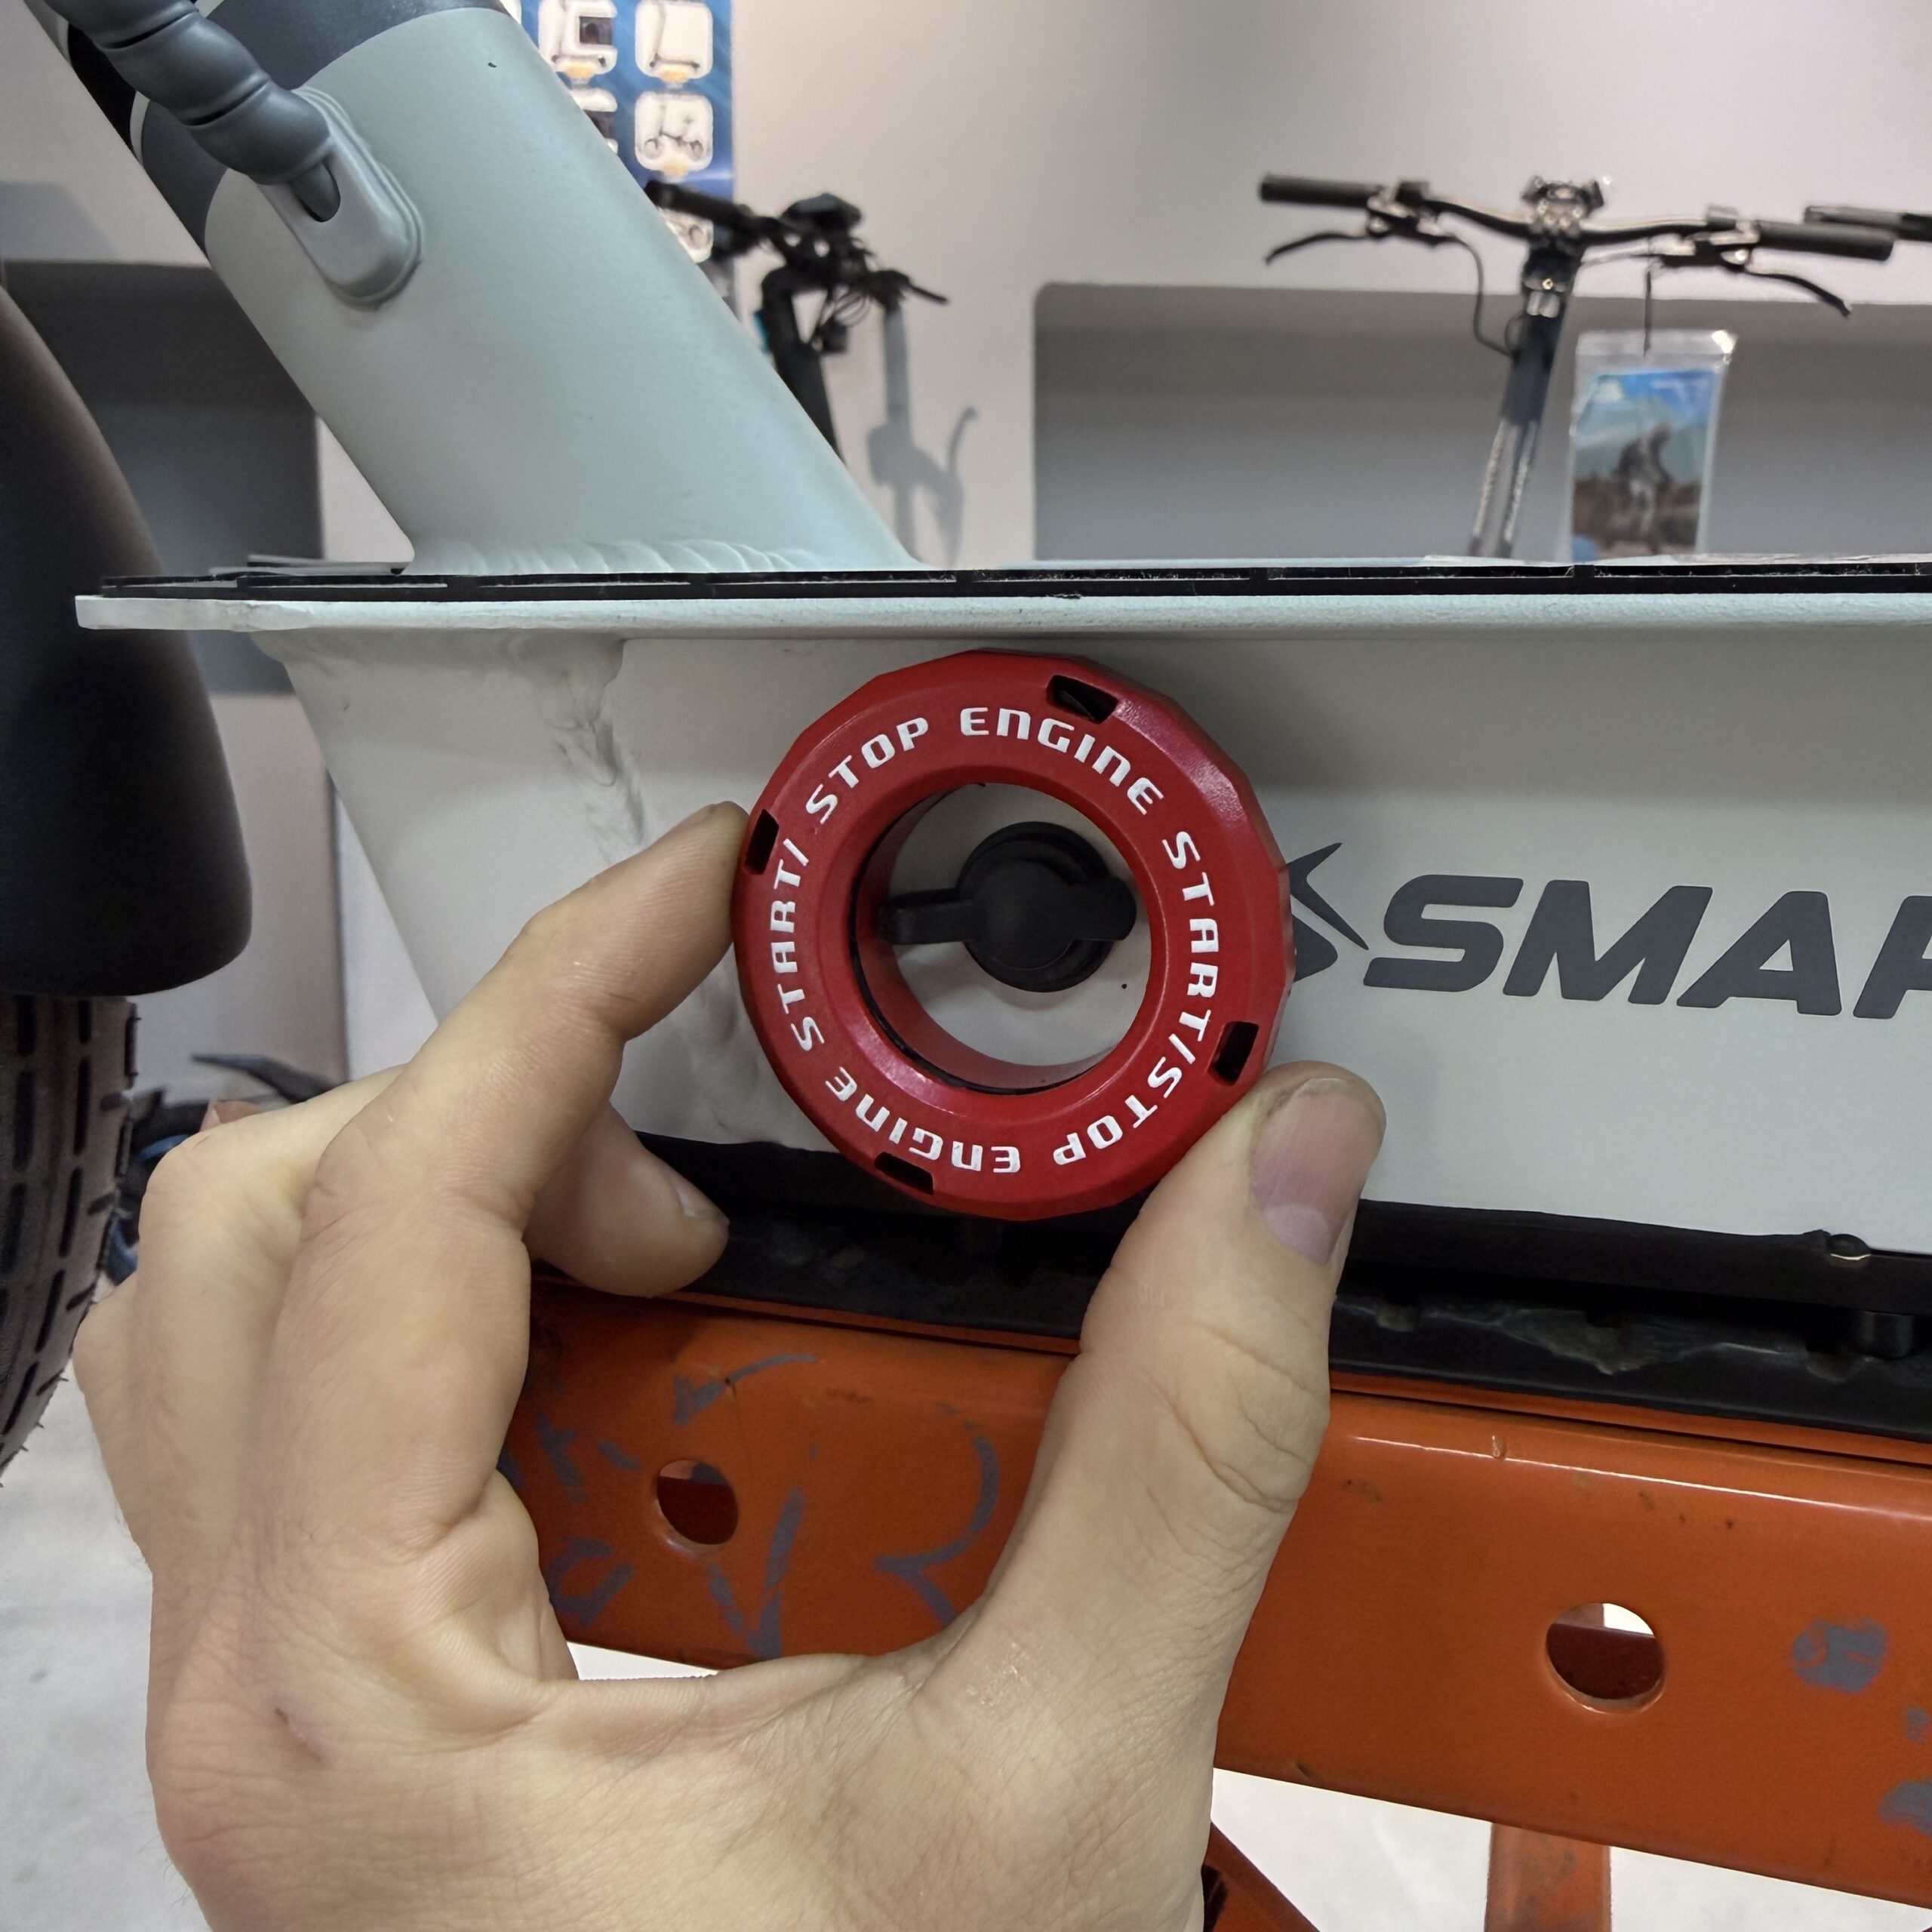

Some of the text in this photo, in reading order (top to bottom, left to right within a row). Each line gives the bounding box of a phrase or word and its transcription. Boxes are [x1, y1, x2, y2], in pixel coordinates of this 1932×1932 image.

[804, 717, 929, 825] STOP
[959, 706, 1164, 816] ENGINE
[824, 1066, 1021, 1174] ENGINE
